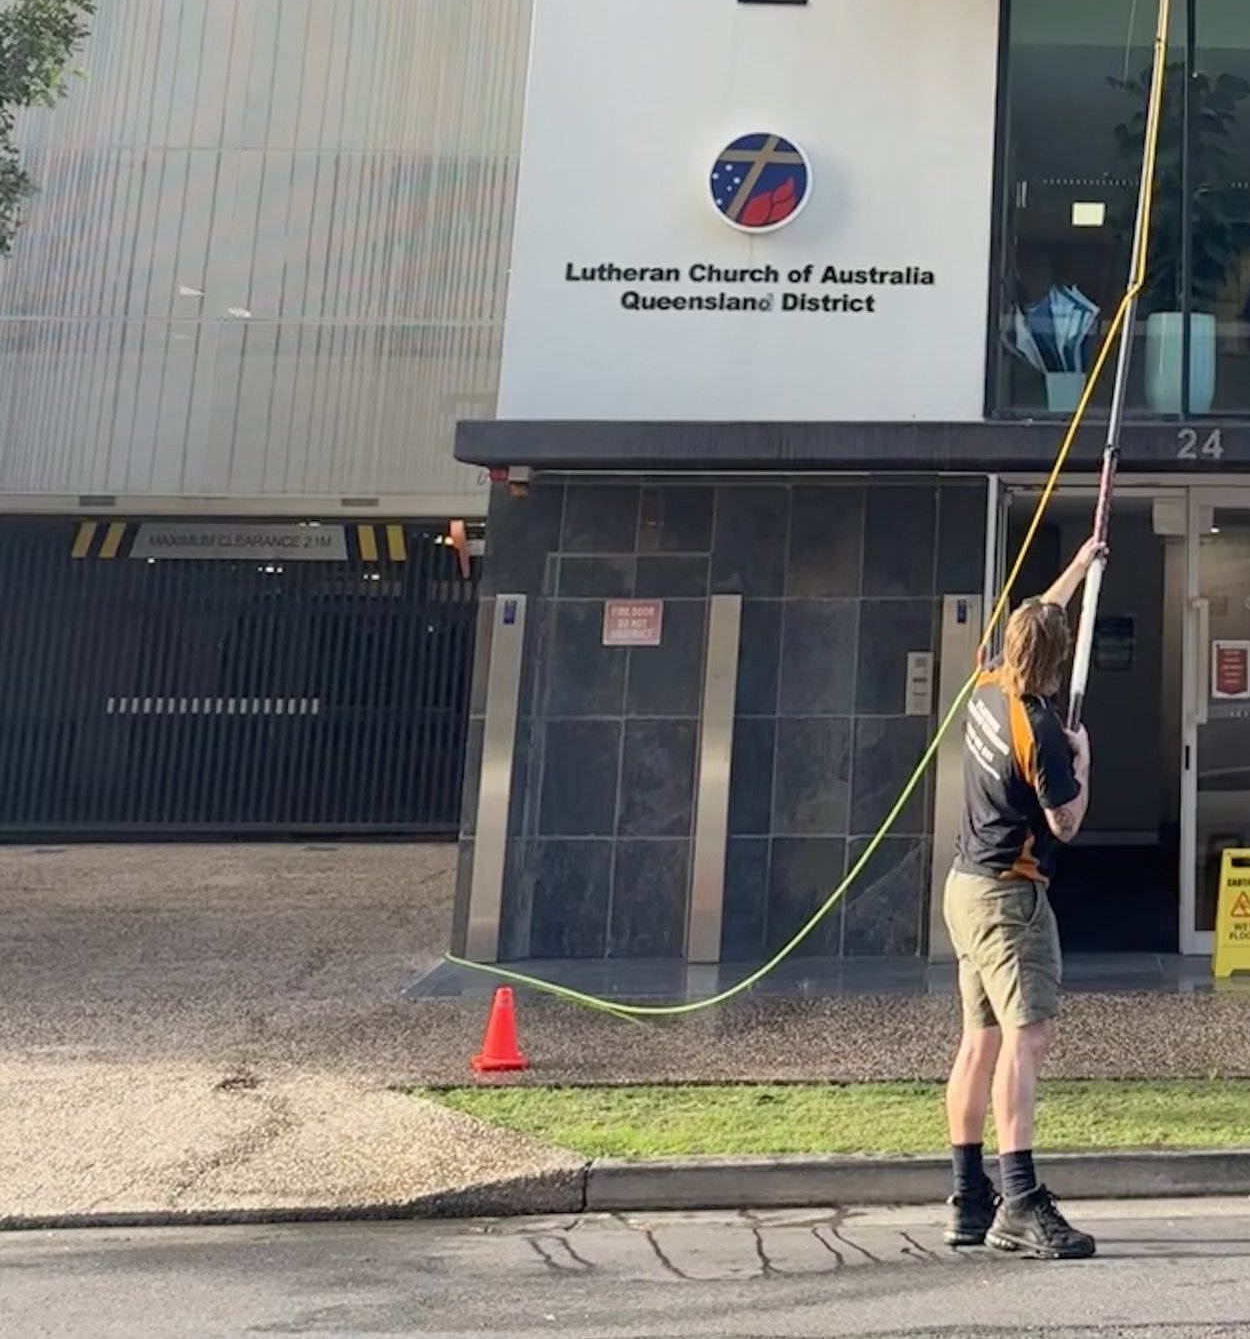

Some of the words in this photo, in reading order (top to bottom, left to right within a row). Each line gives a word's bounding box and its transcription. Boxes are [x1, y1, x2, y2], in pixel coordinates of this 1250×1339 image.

[565, 262, 681, 282] Lutheran
[688, 263, 779, 283] Church
[787, 264, 814, 284] of
[819, 265, 935, 285] Australia
[620, 290, 774, 311] Queensland
[782, 292, 876, 313] District
[1177, 428, 1224, 459] 24
[217, 535, 300, 548] CLEARANCE
